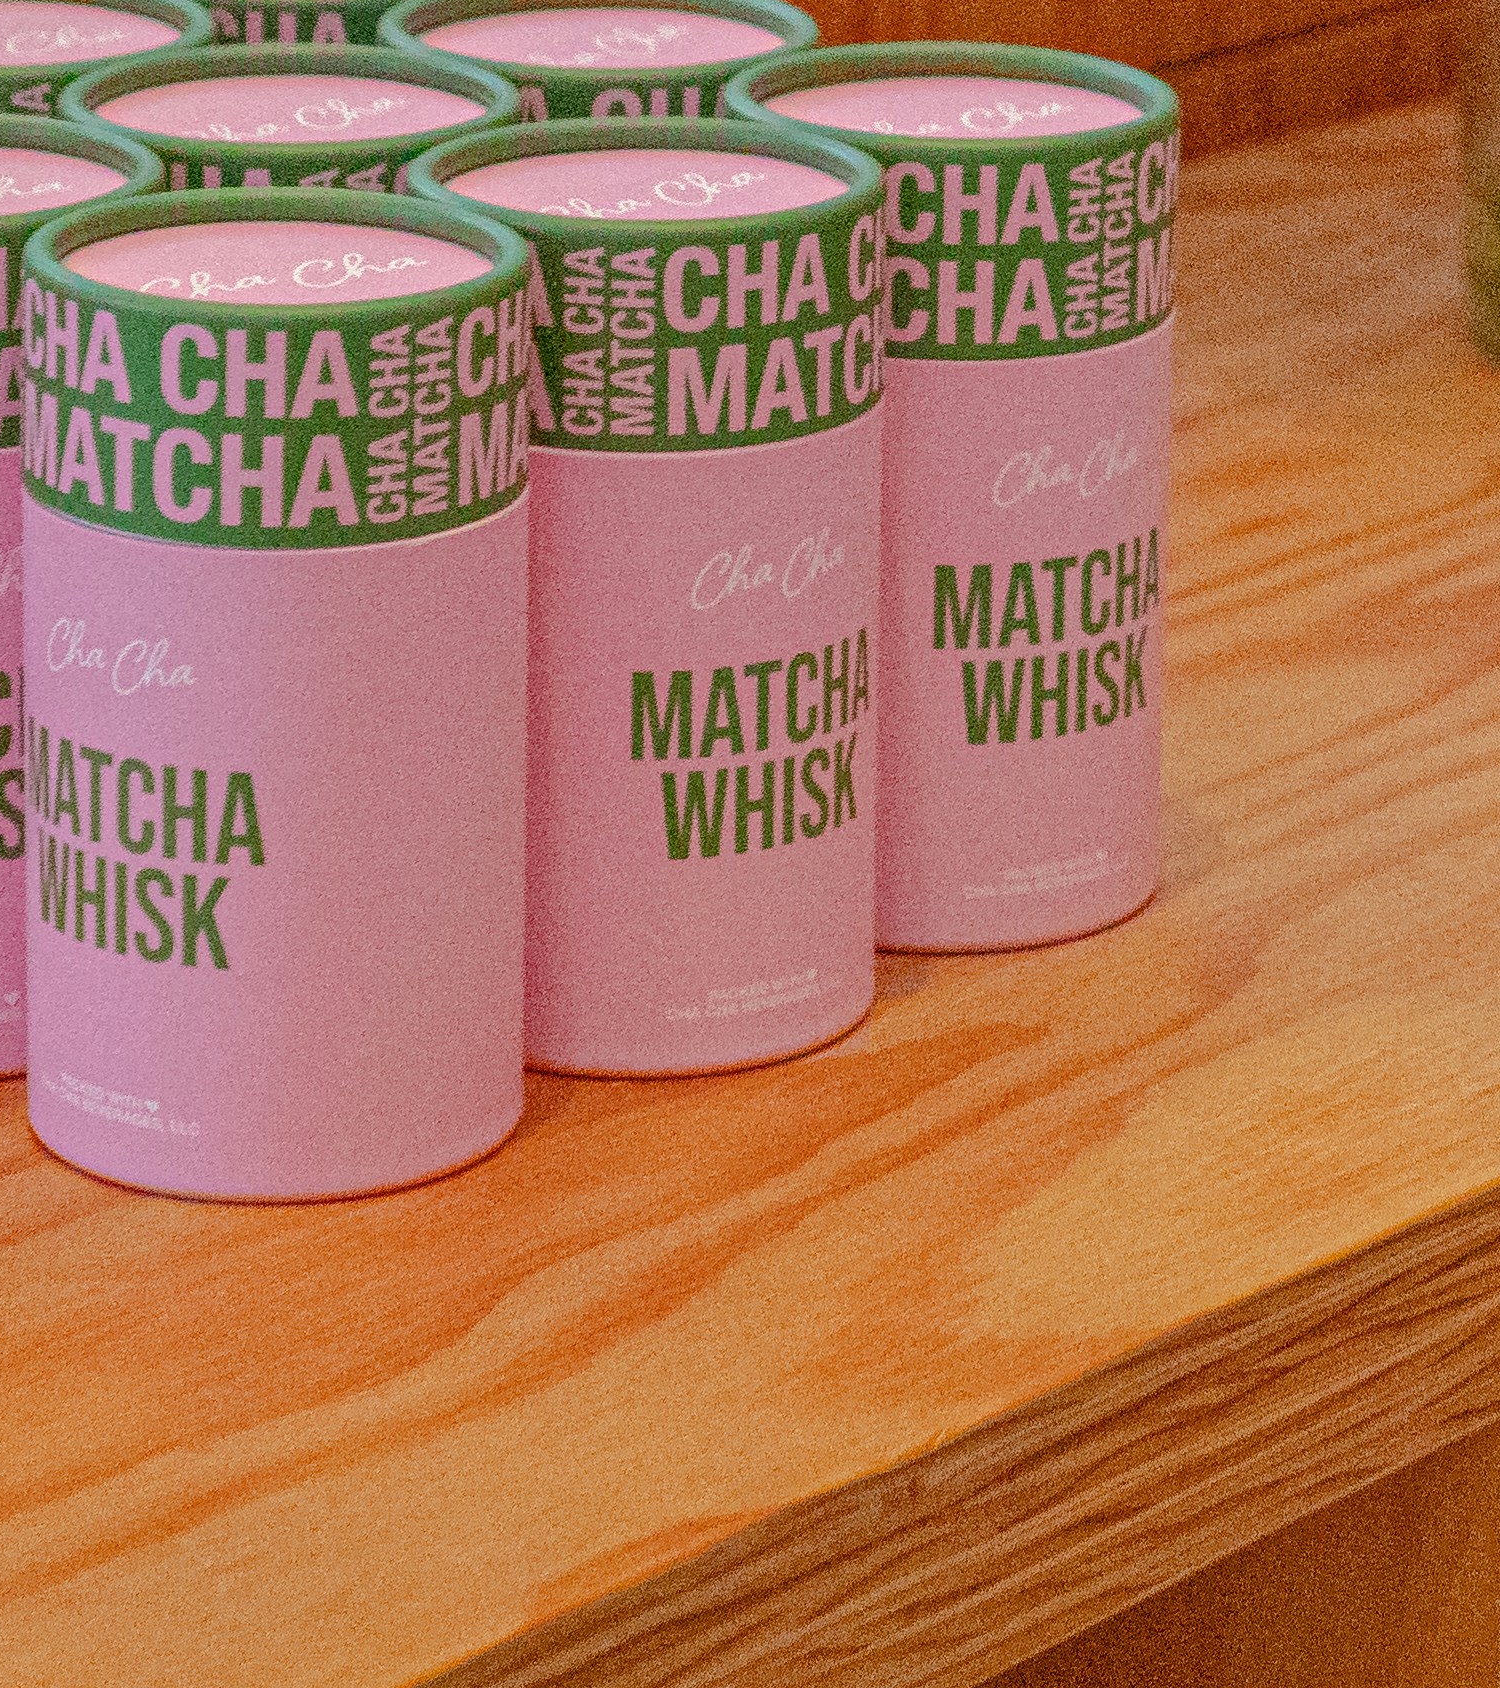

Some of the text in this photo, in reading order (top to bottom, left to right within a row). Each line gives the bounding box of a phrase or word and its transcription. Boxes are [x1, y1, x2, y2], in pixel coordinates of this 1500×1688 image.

[653, 172, 768, 208] Cha
[882, 160, 1060, 247] CHA
[1064, 157, 1104, 340] CHA CHA
[1101, 150, 1137, 334] MATCHA
[292, 251, 428, 288] Cha
[662, 231, 832, 335] CHA
[882, 254, 1060, 346] CHA
[23, 277, 360, 421] CHA CHA
[561, 246, 605, 438] CHA CHA
[609, 246, 657, 438] MATCHA
[23, 377, 361, 529] MATCHA
[366, 323, 411, 526] CHA CHA
[412, 315, 454, 517] MATCHA
[992, 444, 1074, 510] Cha
[690, 525, 846, 611] Cha Cha
[933, 526, 1160, 651] MATCHA
[47, 616, 197, 697] Cha Cha
[631, 627, 870, 762] MATCHA
[961, 624, 1149, 746] WHISK
[26, 714, 265, 867] MATCHA
[660, 730, 858, 861] WHISK
[38, 824, 230, 972] WHISK
